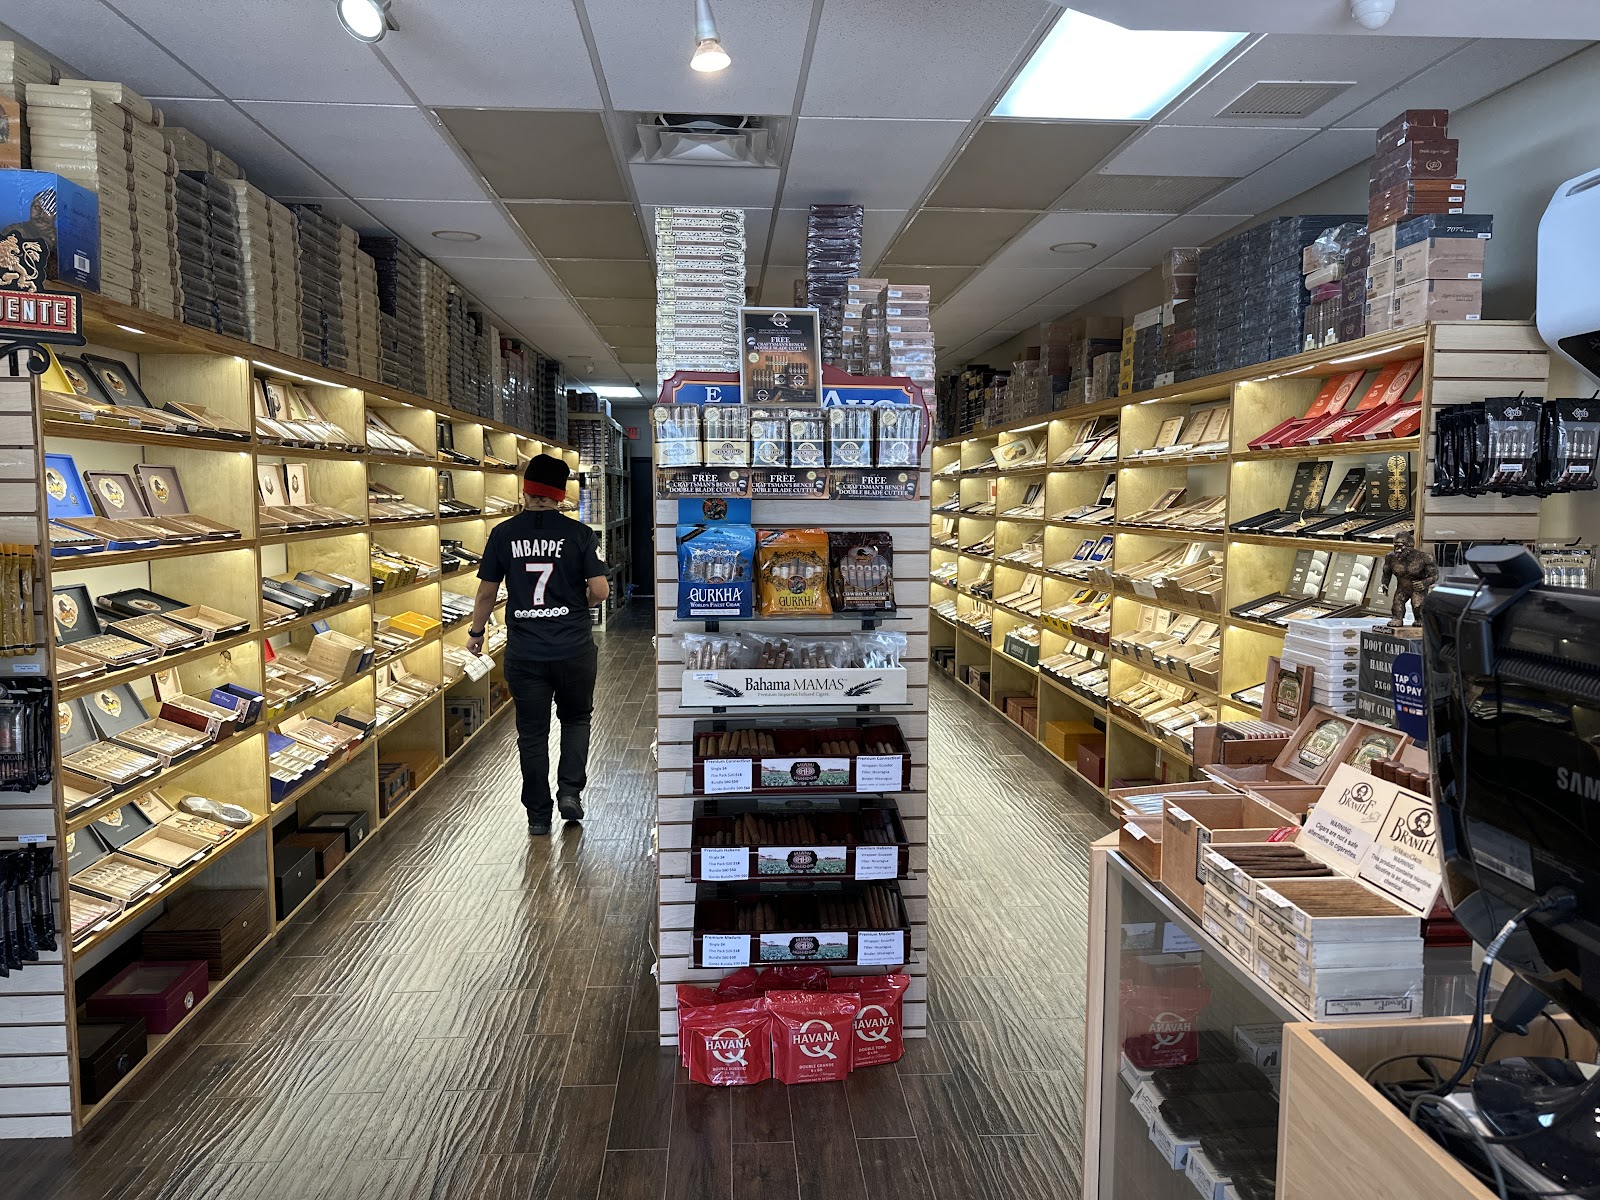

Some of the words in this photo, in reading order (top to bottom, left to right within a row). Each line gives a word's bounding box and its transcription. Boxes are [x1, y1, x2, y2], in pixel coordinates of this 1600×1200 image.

[0, 296, 68, 327] ENTE
[692, 474, 719, 482] FREE
[769, 474, 796, 482] FREE
[861, 476, 888, 484] FREE
[511, 538, 565, 558] MBAPPÉ
[525, 562, 554, 606] 7
[687, 588, 743, 602] GURKHA
[1363, 638, 1382, 652] BOOT
[1385, 642, 1406, 655] CAMP
[745, 677, 790, 691] Bahama
[793, 678, 844, 691] MAMAS
[1394, 673, 1410, 684] TAP
[1395, 683, 1406, 693] TO
[1406, 685, 1422, 697] PAY
[1358, 698, 1375, 714] BOOT
[1376, 702, 1395, 720] CAMP
[1329, 819, 1352, 836] WARNING:
[1315, 822, 1330, 835] Cigars
[1329, 829, 1337, 839] are
[1336, 832, 1344, 843] not
[1347, 840, 1358, 849] safe
[1307, 829, 1329, 845] alternative
[1328, 839, 1334, 847] to
[1333, 843, 1357, 860] cigarettes.
[1393, 856, 1415, 870] WARNING:
[1371, 853, 1380, 862] This
[1379, 858, 1396, 871] product
[1395, 866, 1414, 879] contains
[1413, 875, 1432, 889] nicotine.
[1374, 863, 1391, 876] Nicotine
[1400, 879, 1421, 892] addictive
[706, 1038, 751, 1050] HAVANA
[793, 1031, 840, 1044] HAVANA
